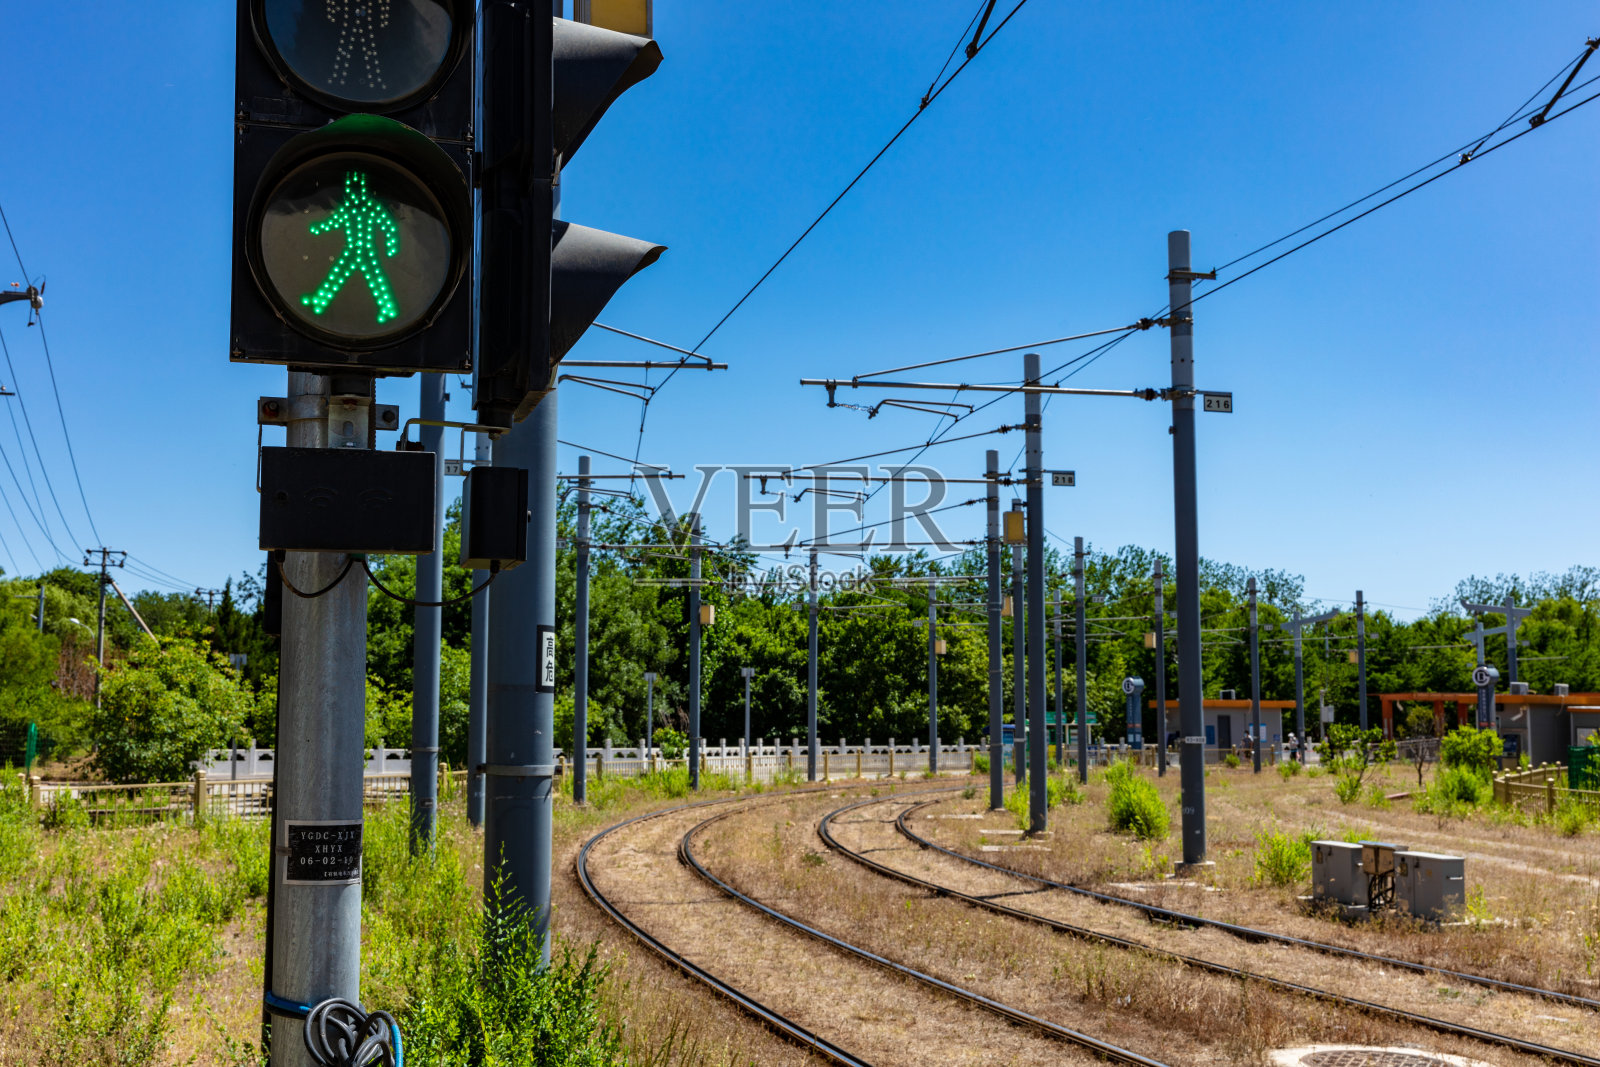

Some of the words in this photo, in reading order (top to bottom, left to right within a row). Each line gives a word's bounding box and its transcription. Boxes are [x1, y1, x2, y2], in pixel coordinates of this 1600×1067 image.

[1206, 399, 1230, 409] 216
[545, 636, 554, 682] 高危
[315, 844, 343, 853] XHYX
